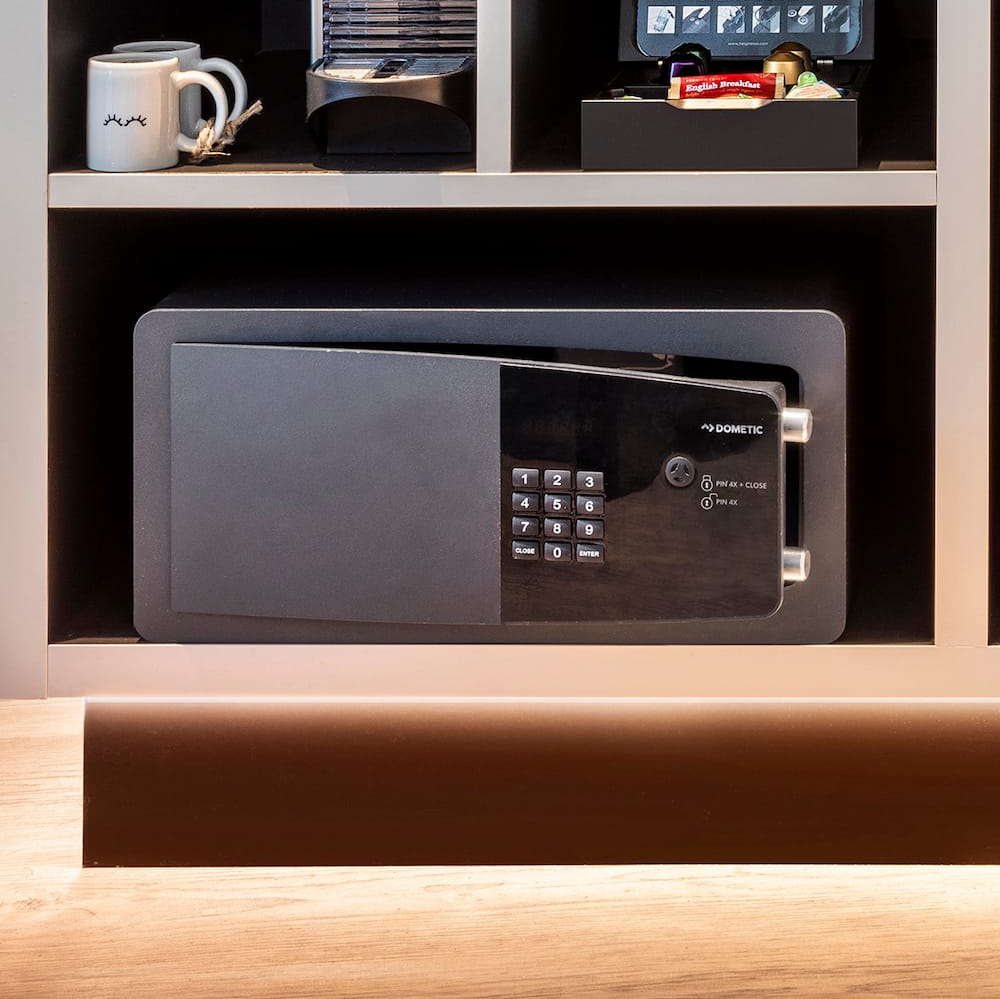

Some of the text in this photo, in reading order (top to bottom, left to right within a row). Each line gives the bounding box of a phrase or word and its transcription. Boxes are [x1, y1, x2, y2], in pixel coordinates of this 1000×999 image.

[685, 82, 718, 93] English
[719, 79, 761, 90] Breakfast
[715, 424, 763, 435] DOMETIC
[521, 473, 594, 488] 1 2 3
[715, 480, 728, 488] PIN
[520, 497, 594, 512] 4 5 6
[715, 498, 728, 506] PIN
[520, 521, 594, 535] 7 8 9
[515, 547, 536, 555] CLOSE
[553, 547, 562, 558] 0
